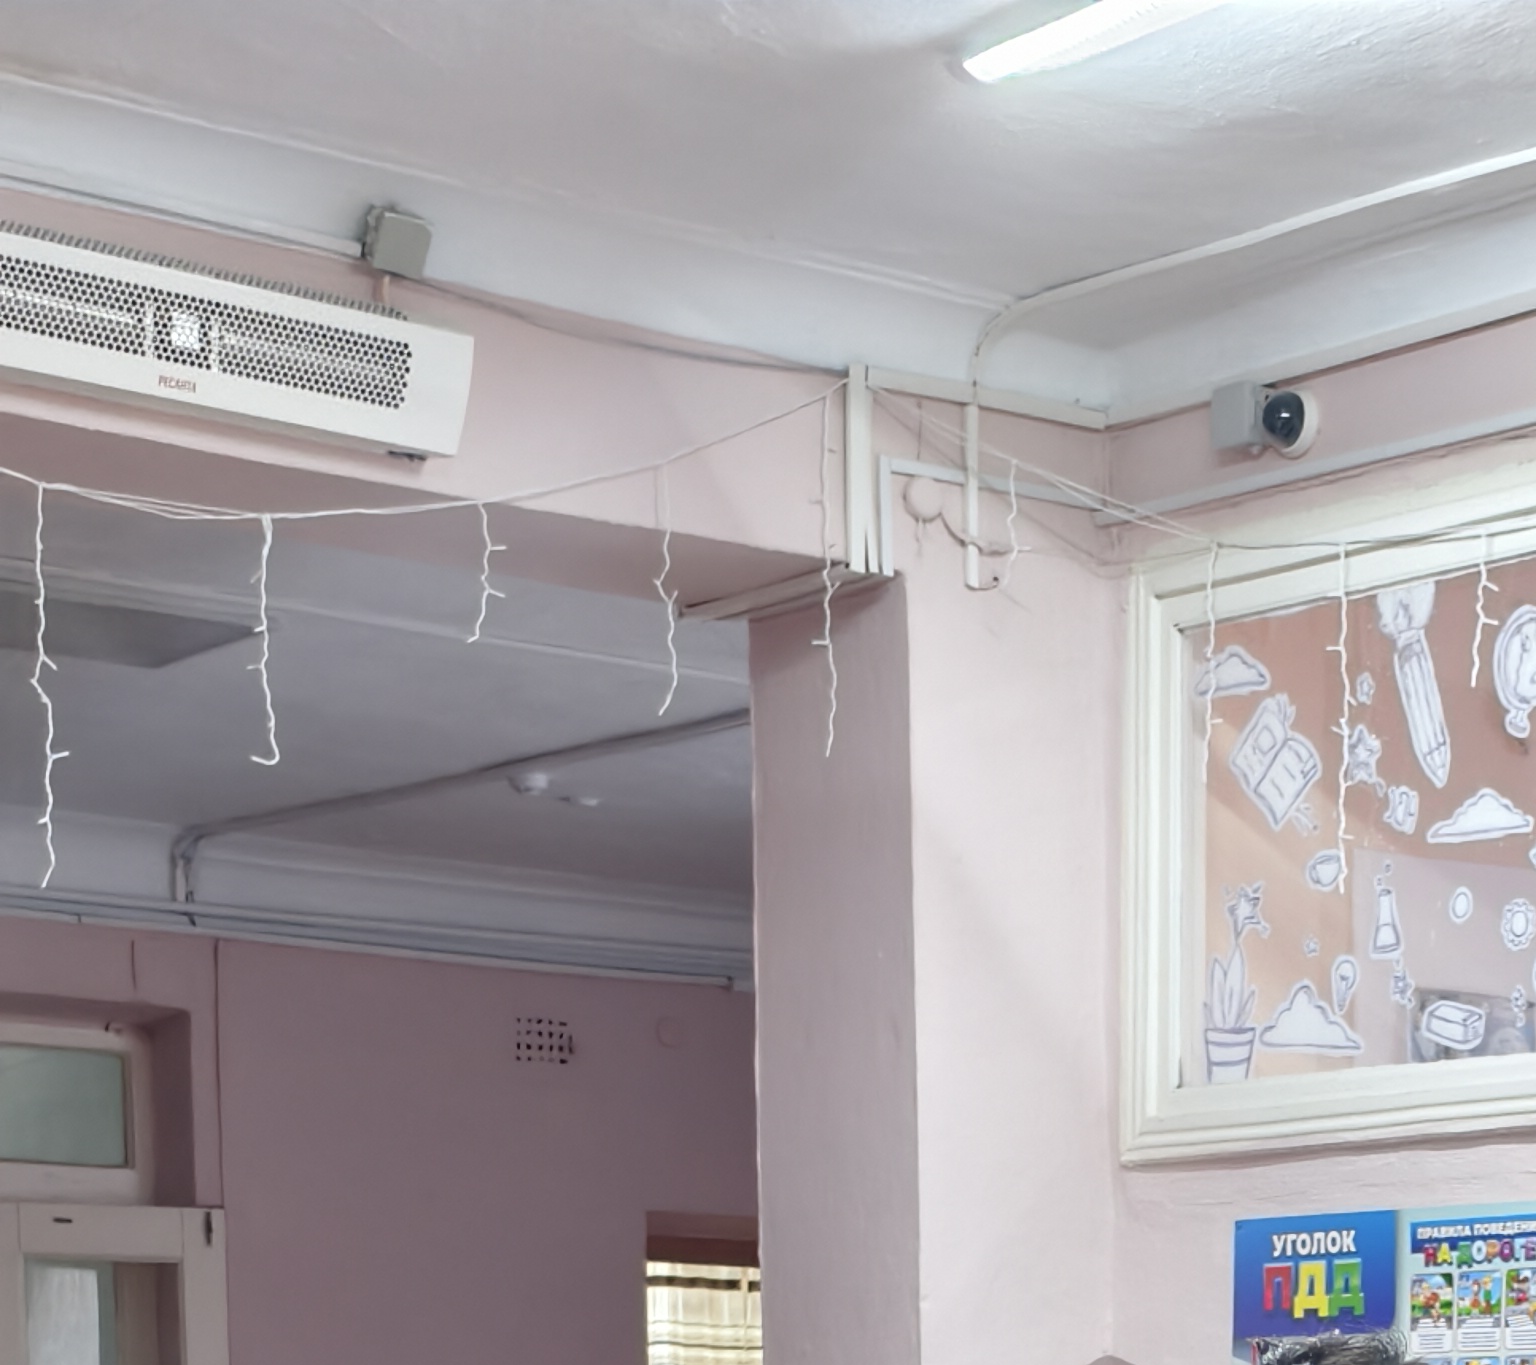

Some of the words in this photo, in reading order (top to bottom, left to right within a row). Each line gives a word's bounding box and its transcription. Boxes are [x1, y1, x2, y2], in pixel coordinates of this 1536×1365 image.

[1272, 1229, 1356, 1257] УГОЛОК
[1417, 1225, 1471, 1239] ПРАВИЛА
[1423, 1242, 1453, 1267] НА
[1262, 1258, 1365, 1318] ПДД
